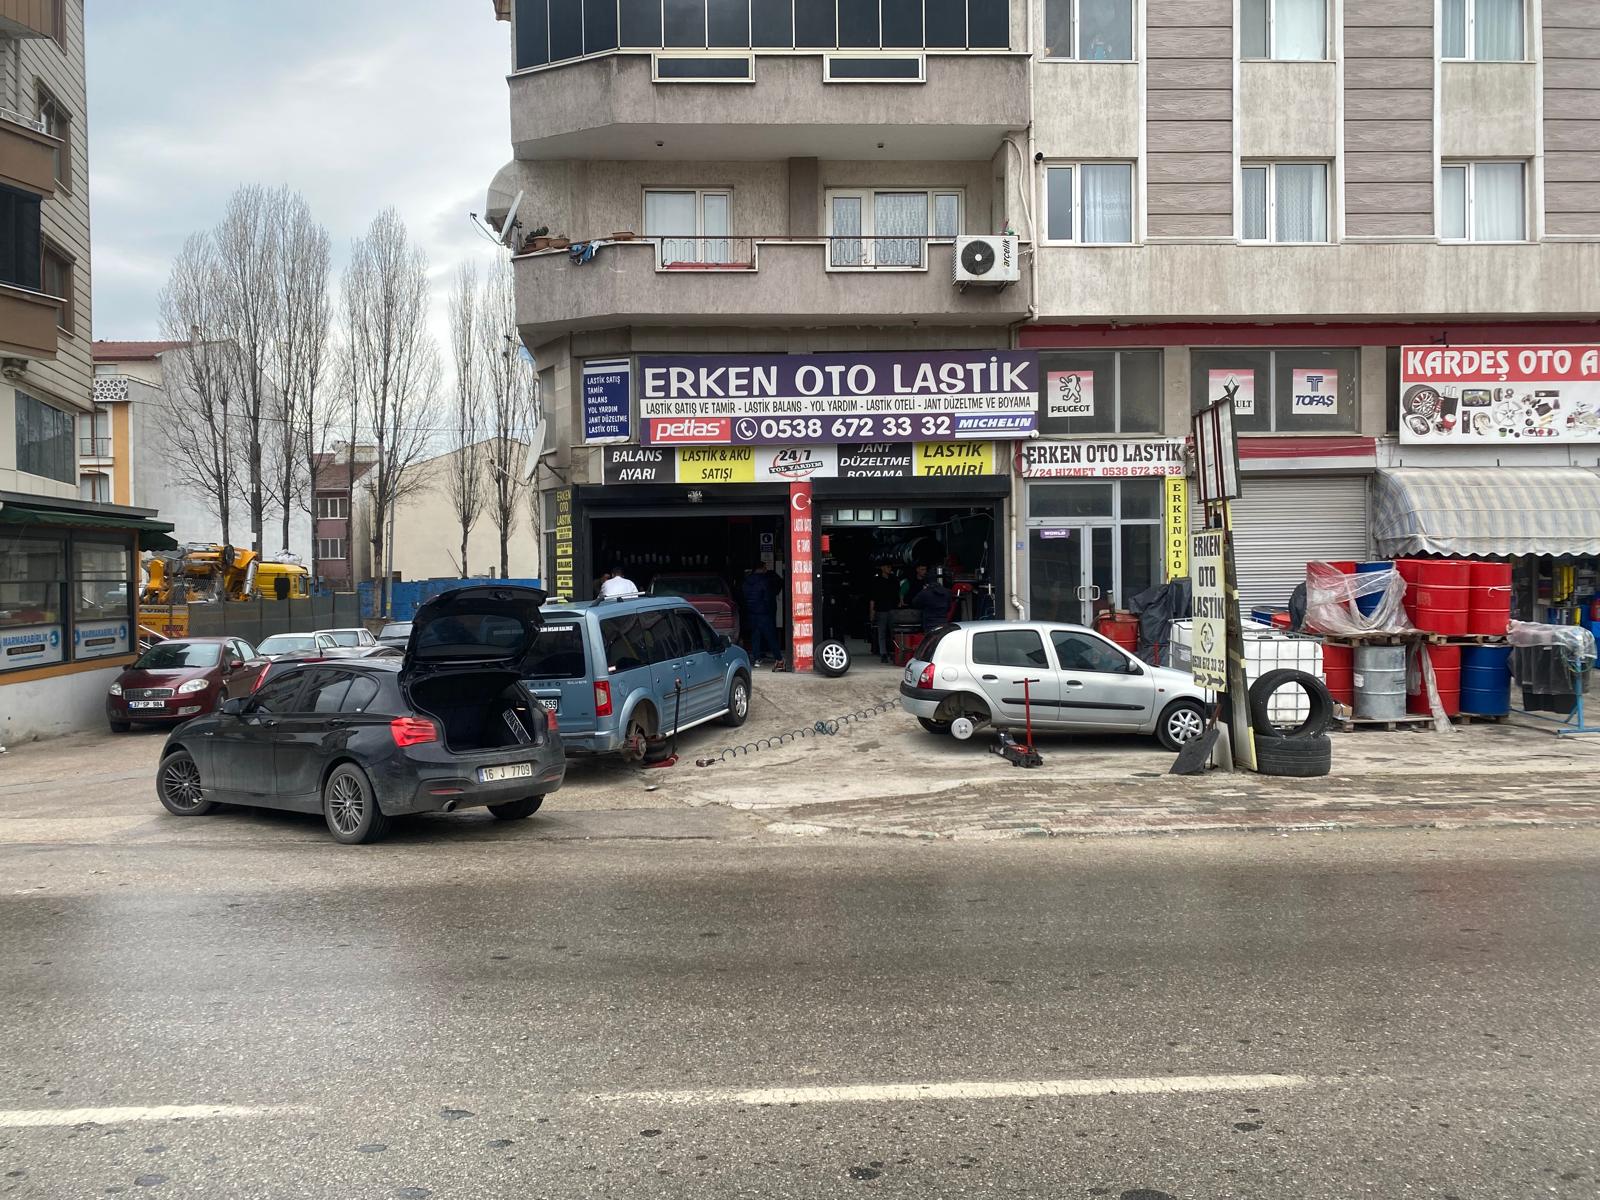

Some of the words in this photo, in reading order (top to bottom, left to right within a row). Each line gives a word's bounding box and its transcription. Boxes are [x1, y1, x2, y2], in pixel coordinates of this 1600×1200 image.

[1408, 350, 1509, 381] KARDEŞ
[1518, 350, 1572, 374] OTO
[644, 366, 778, 398] ERKEN
[795, 364, 876, 396] OTO
[894, 356, 1030, 393] LASTİK
[588, 396, 607, 404] BALANS
[646, 400, 672, 414] LASTİK
[675, 402, 697, 416] SATIŞ
[699, 402, 708, 414] VE
[712, 399, 736, 413] TAMİR
[744, 399, 770, 413] LASTİK
[772, 401, 802, 413] BALANS
[810, 401, 825, 412] YOL
[827, 400, 857, 411] YARDIM
[866, 396, 892, 411] LASTİK
[894, 396, 915, 410] OTELİ
[924, 398, 941, 410] JANT
[944, 396, 983, 410] DÜZELTME
[985, 397, 996, 408] VE
[998, 396, 1030, 408] BOYAMA
[1296, 396, 1334, 407] TOFAŞ
[656, 420, 720, 440] petlas
[760, 418, 822, 438] 0538
[831, 418, 874, 437] 672
[882, 417, 912, 435] 33
[921, 416, 950, 435] 32
[958, 417, 1032, 429] MICHELIN
[682, 448, 717, 461] LASTİK
[720, 450, 727, 460] &
[858, 443, 892, 453] JANT
[924, 442, 983, 458] LASTİK
[1026, 446, 1081, 464] ERKEN
[1086, 444, 1117, 462] OTO
[1122, 440, 1181, 462] LASTİK
[612, 450, 662, 463] BALANS
[840, 456, 910, 466] DÜZELTME
[788, 462, 822, 471] YARDIM
[924, 462, 983, 476] TAMİRİ
[1102, 467, 1128, 476] 0538
[1131, 466, 1150, 476] 672
[1153, 466, 1165, 475] 33
[1169, 466, 1181, 474] 32
[619, 469, 655, 480] AYARI
[702, 468, 732, 481] SATIŞI
[1193, 535, 1220, 557] ERKEN
[1198, 566, 1216, 587] OTO
[1192, 592, 1225, 619] LASTİK
[484, 769, 494, 780] 16
[500, 768, 505, 778] J
[511, 764, 530, 777] 7709
